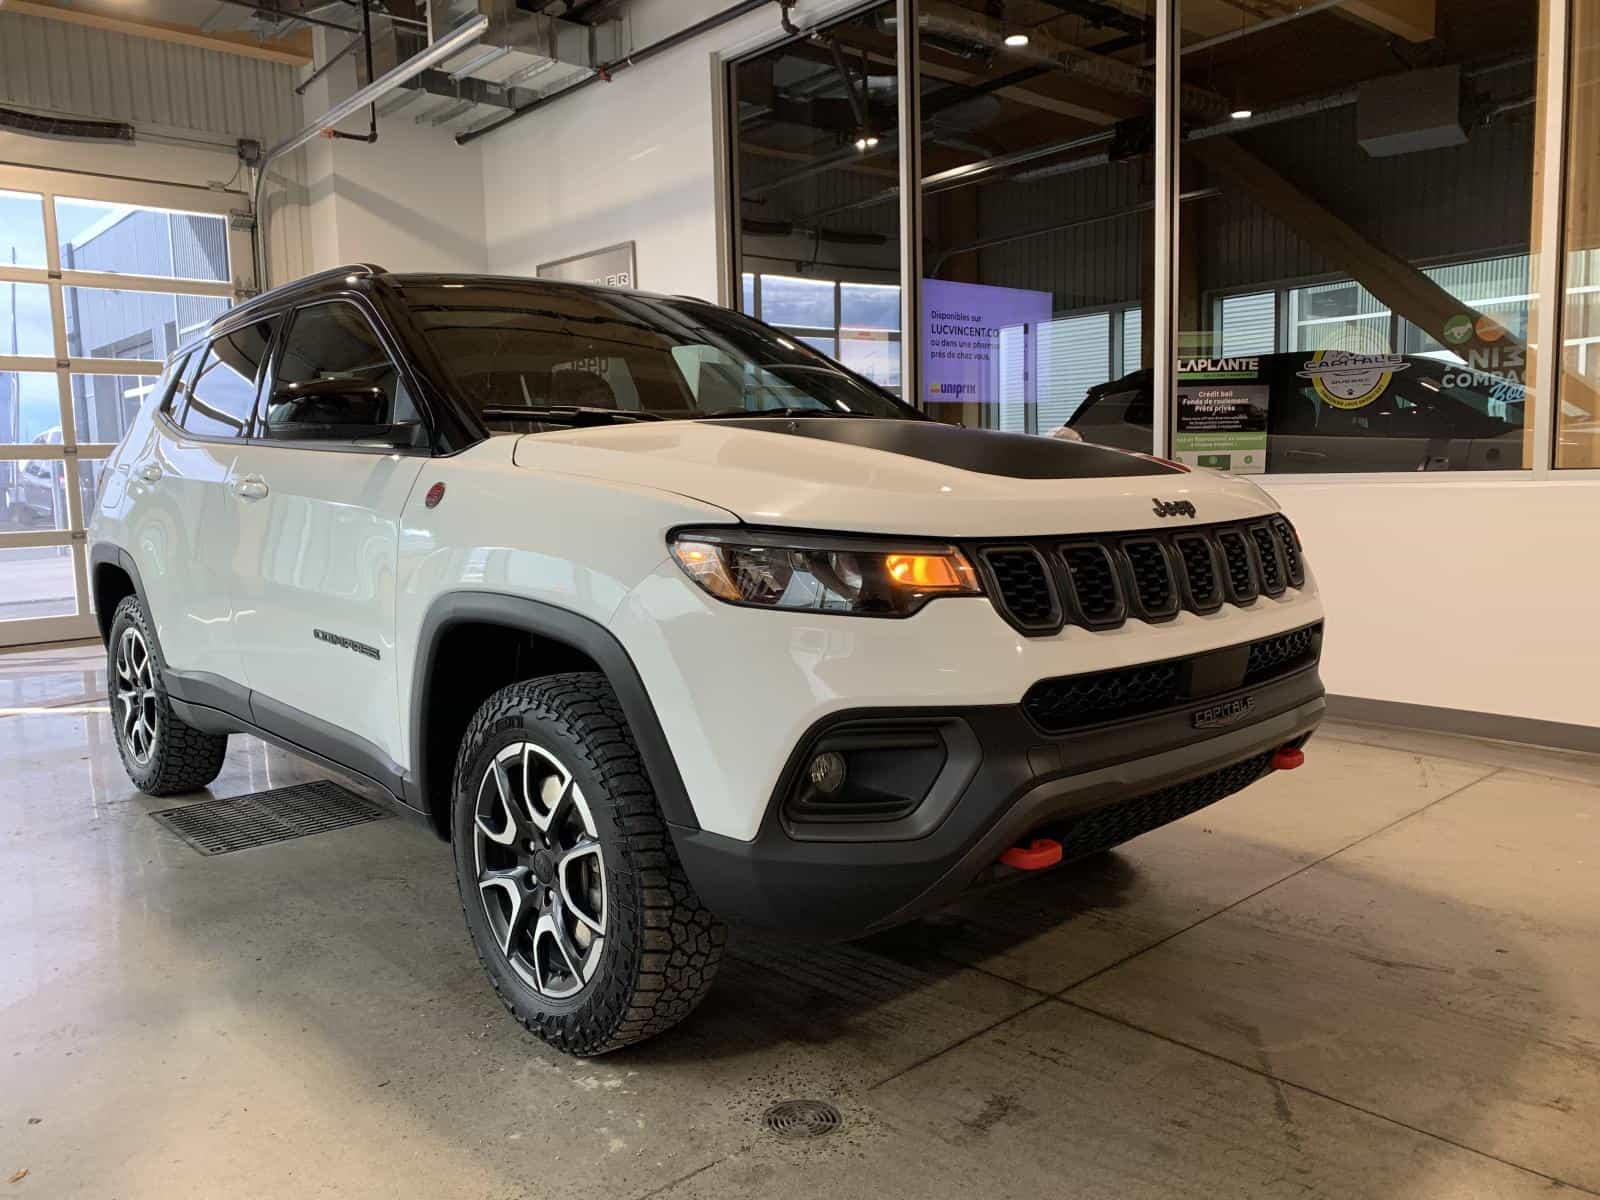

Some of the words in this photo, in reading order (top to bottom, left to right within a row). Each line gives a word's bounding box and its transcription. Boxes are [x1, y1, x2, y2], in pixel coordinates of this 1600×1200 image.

[931, 310, 970, 322] Disponibles
[931, 324, 1000, 338] LUCVINCENT.CO
[941, 339, 957, 347] dans
[1177, 358, 1259, 372] LAPLANTE
[1151, 498, 1196, 519] Jeep
[313, 628, 381, 661] COMPASS
[1194, 696, 1256, 722] CAPITALE
